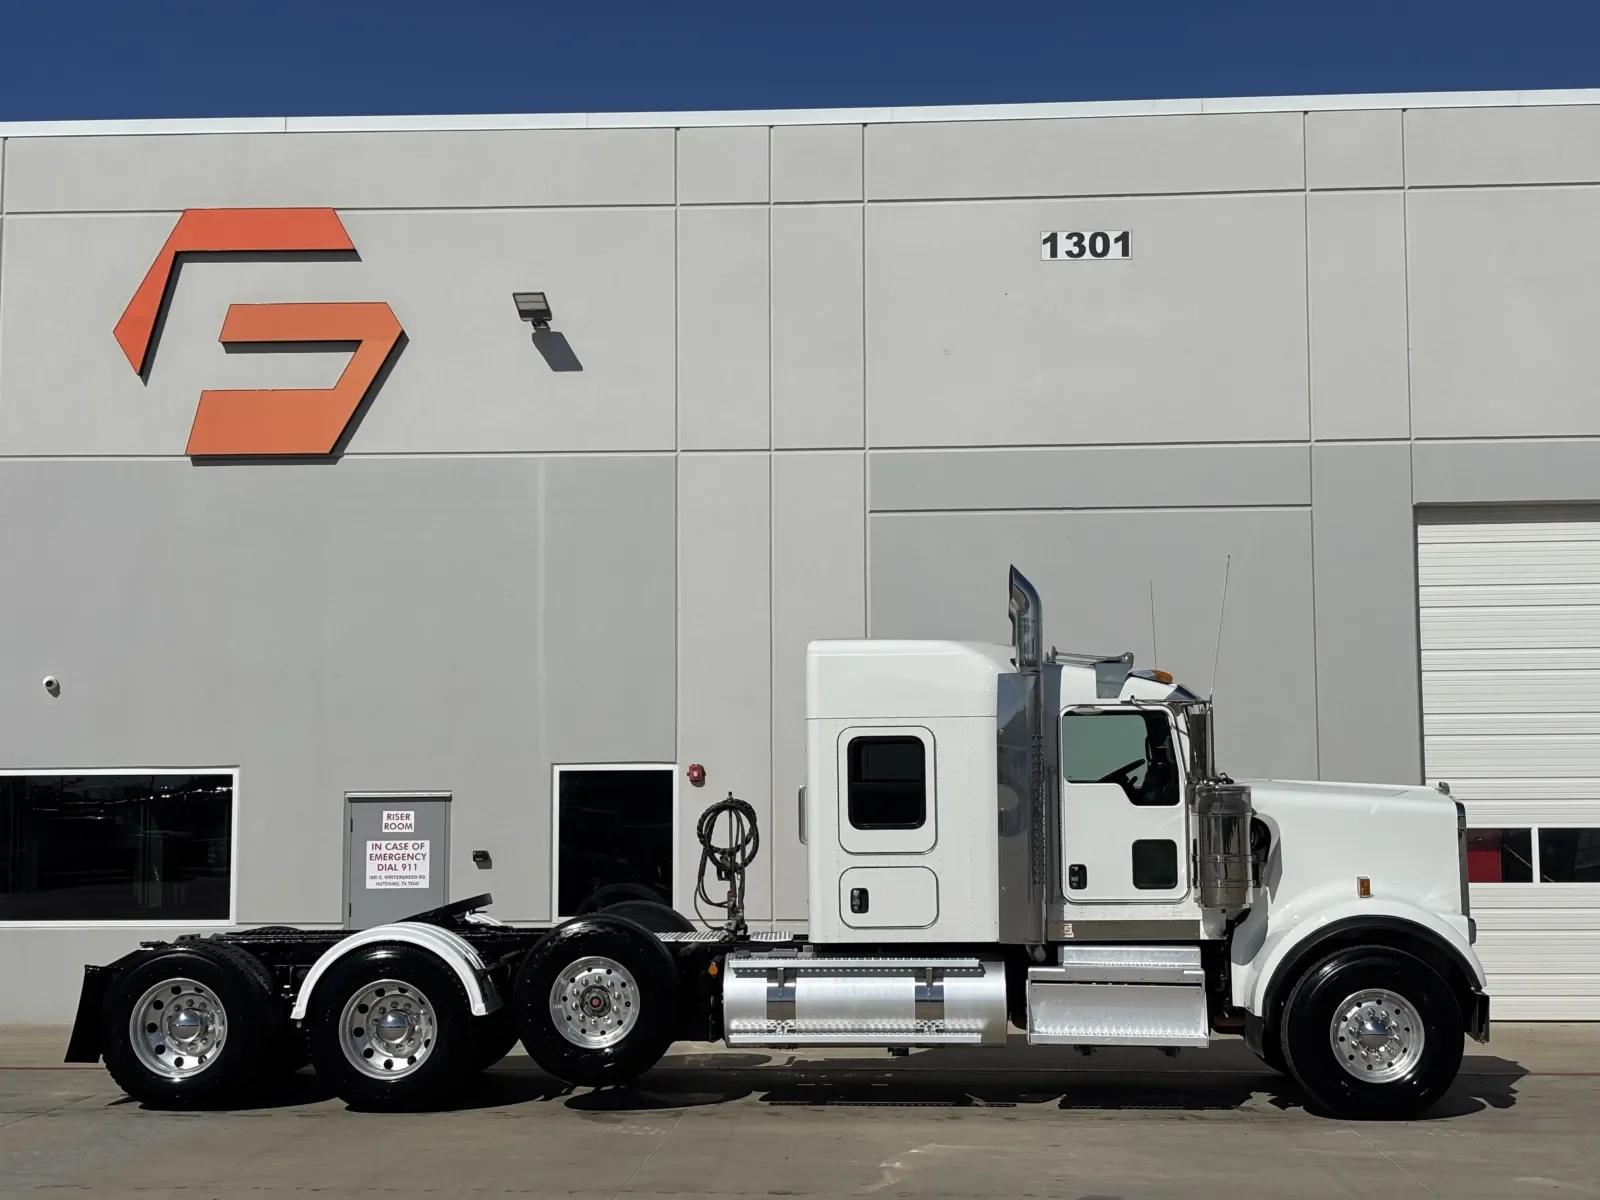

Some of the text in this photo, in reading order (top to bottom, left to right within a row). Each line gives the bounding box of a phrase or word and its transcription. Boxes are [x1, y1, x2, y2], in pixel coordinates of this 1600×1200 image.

[1042, 231, 1130, 258] 1301
[386, 813, 411, 821] RISER
[384, 822, 413, 830] ROOM
[385, 842, 409, 850] CASE
[411, 842, 425, 850] OF
[369, 852, 427, 861] EMERGENCY
[377, 863, 417, 871] DIAL 911
